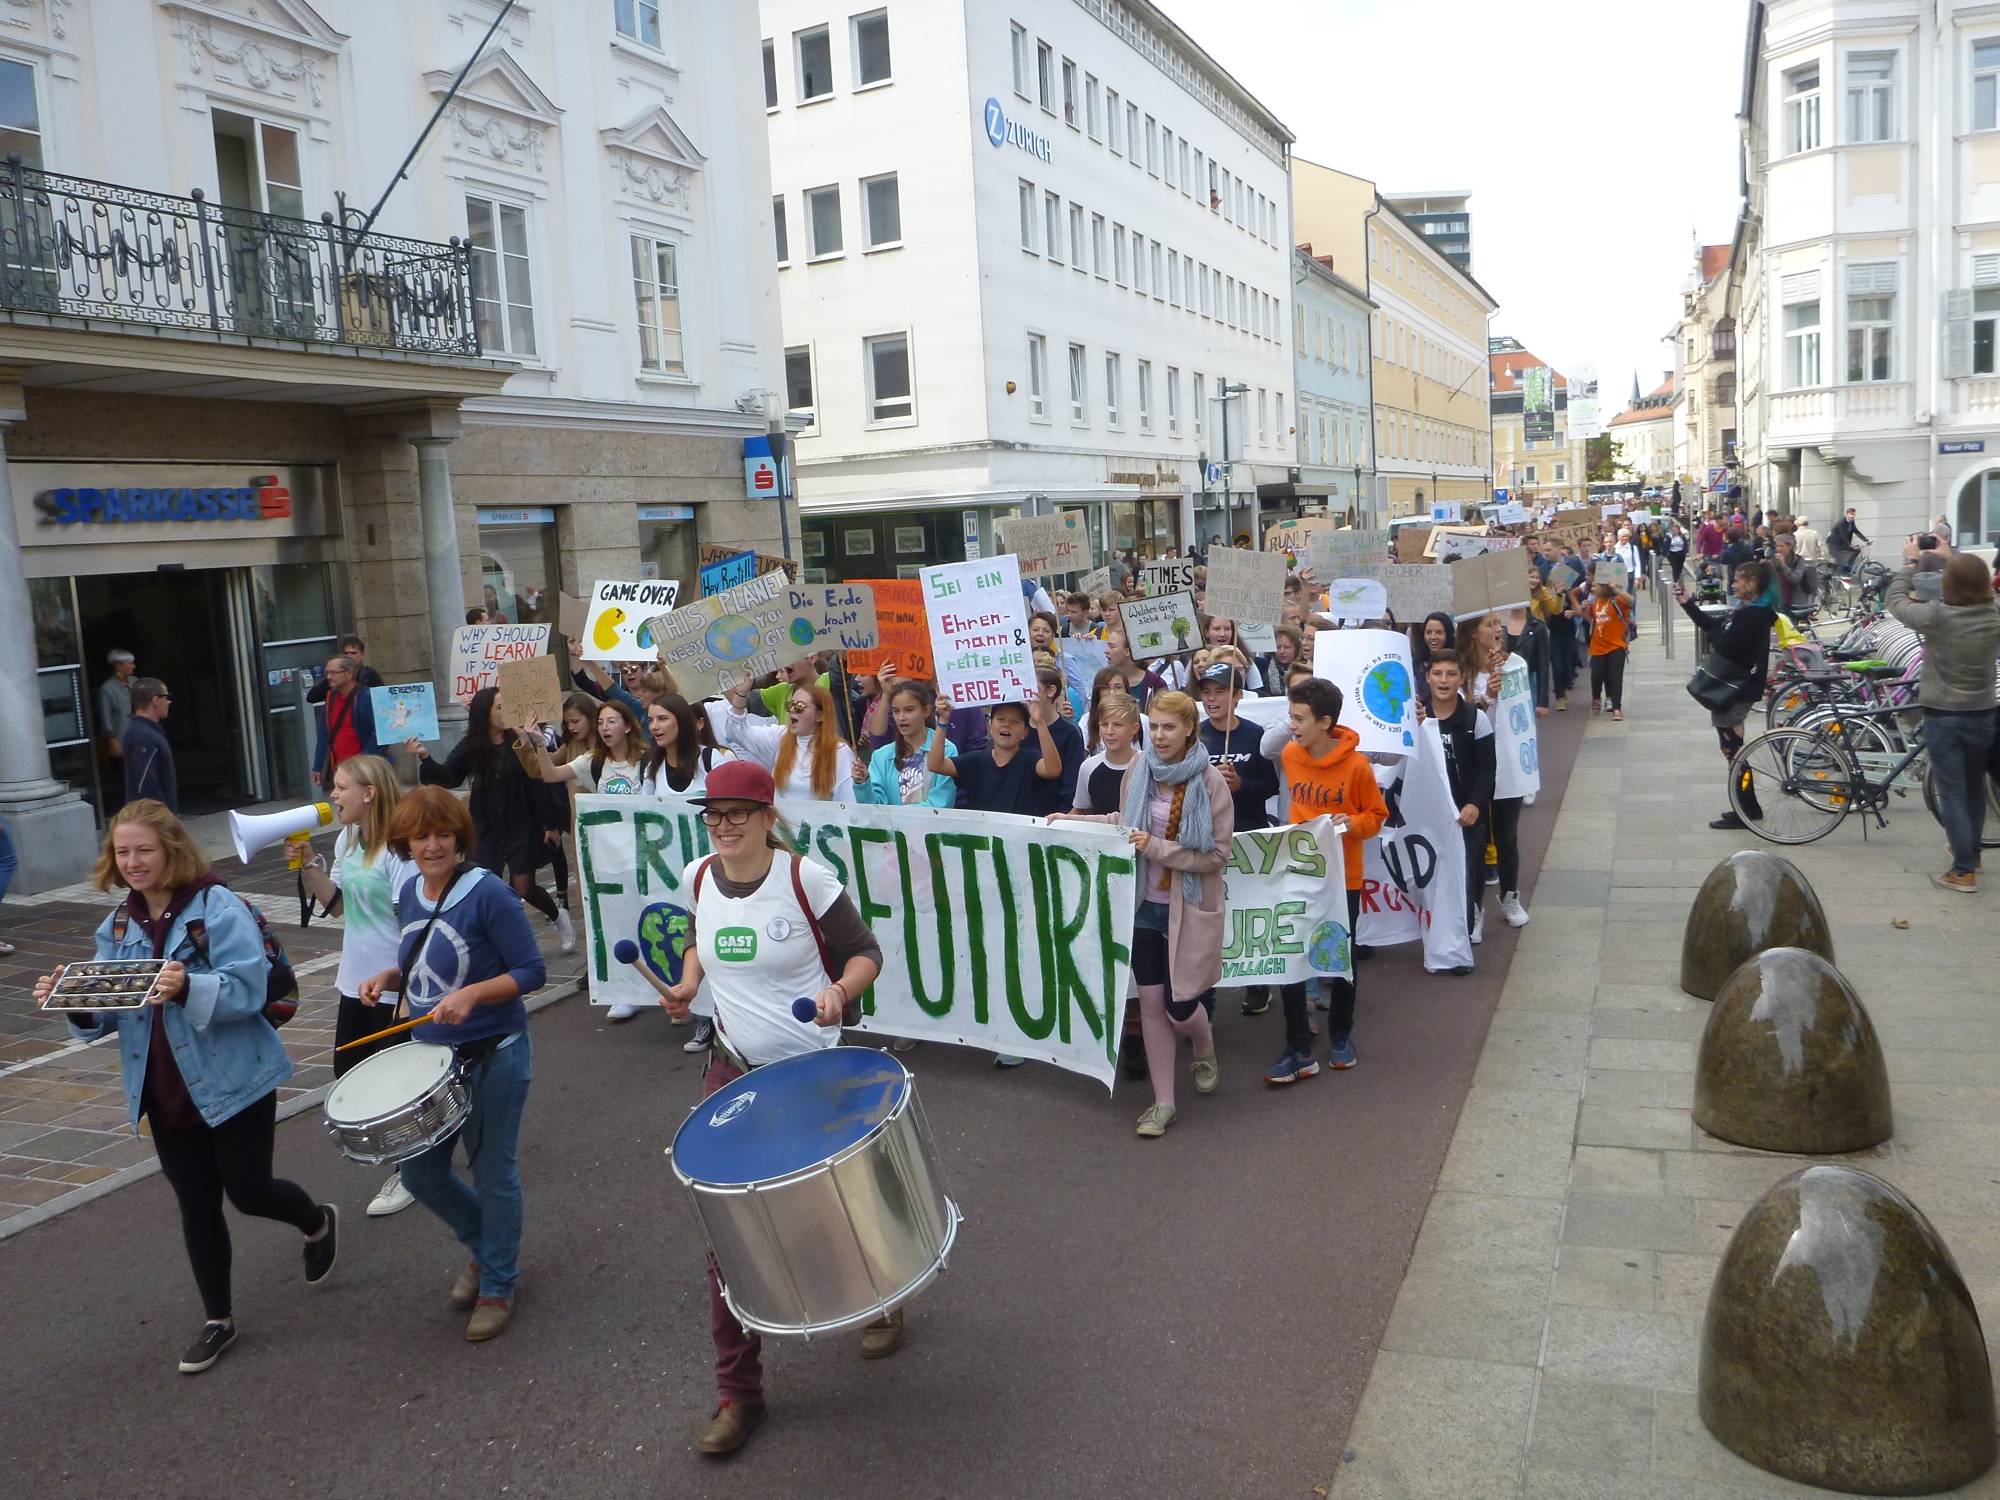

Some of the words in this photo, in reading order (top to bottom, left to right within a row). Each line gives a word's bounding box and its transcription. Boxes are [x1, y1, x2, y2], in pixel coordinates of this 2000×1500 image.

[1006, 118, 1052, 164] ZURICH
[53, 487, 259, 524] SPARKASSE
[491, 512, 523, 521] SPARKASSE
[1018, 556, 1048, 573] UNFT
[1146, 562, 1194, 586] TIME'S
[976, 570, 1003, 589] EIN
[601, 583, 639, 601] GAME
[640, 585, 676, 606] OVER
[789, 590, 814, 610] Die
[824, 587, 863, 608] Erde
[650, 604, 706, 645] THIS
[717, 569, 790, 616] PLANET
[1128, 604, 1158, 618] Welches
[824, 610, 857, 627] kocht
[941, 613, 1011, 635] Ehren-
[1138, 615, 1159, 625] siehst
[461, 627, 488, 642] WHY
[491, 626, 547, 643] SHOULD
[840, 629, 875, 649] Wut
[955, 634, 1008, 650] mann
[1013, 628, 1026, 646] &
[460, 642, 481, 654] WE
[485, 642, 537, 660] LEARN
[666, 637, 707, 665] NEEDS
[946, 651, 992, 670] rette
[999, 649, 1023, 666] die
[466, 661, 477, 673] IF
[482, 661, 497, 670] YO
[692, 655, 715, 675] TO
[740, 648, 778, 677] SHIT
[456, 672, 491, 697] DON'T
[952, 679, 1006, 703] ERDE,
[1222, 829, 1328, 879] AYS
[1222, 901, 1308, 960] URE
[718, 935, 754, 948] GAST
[1222, 957, 1286, 978] VILLACH
